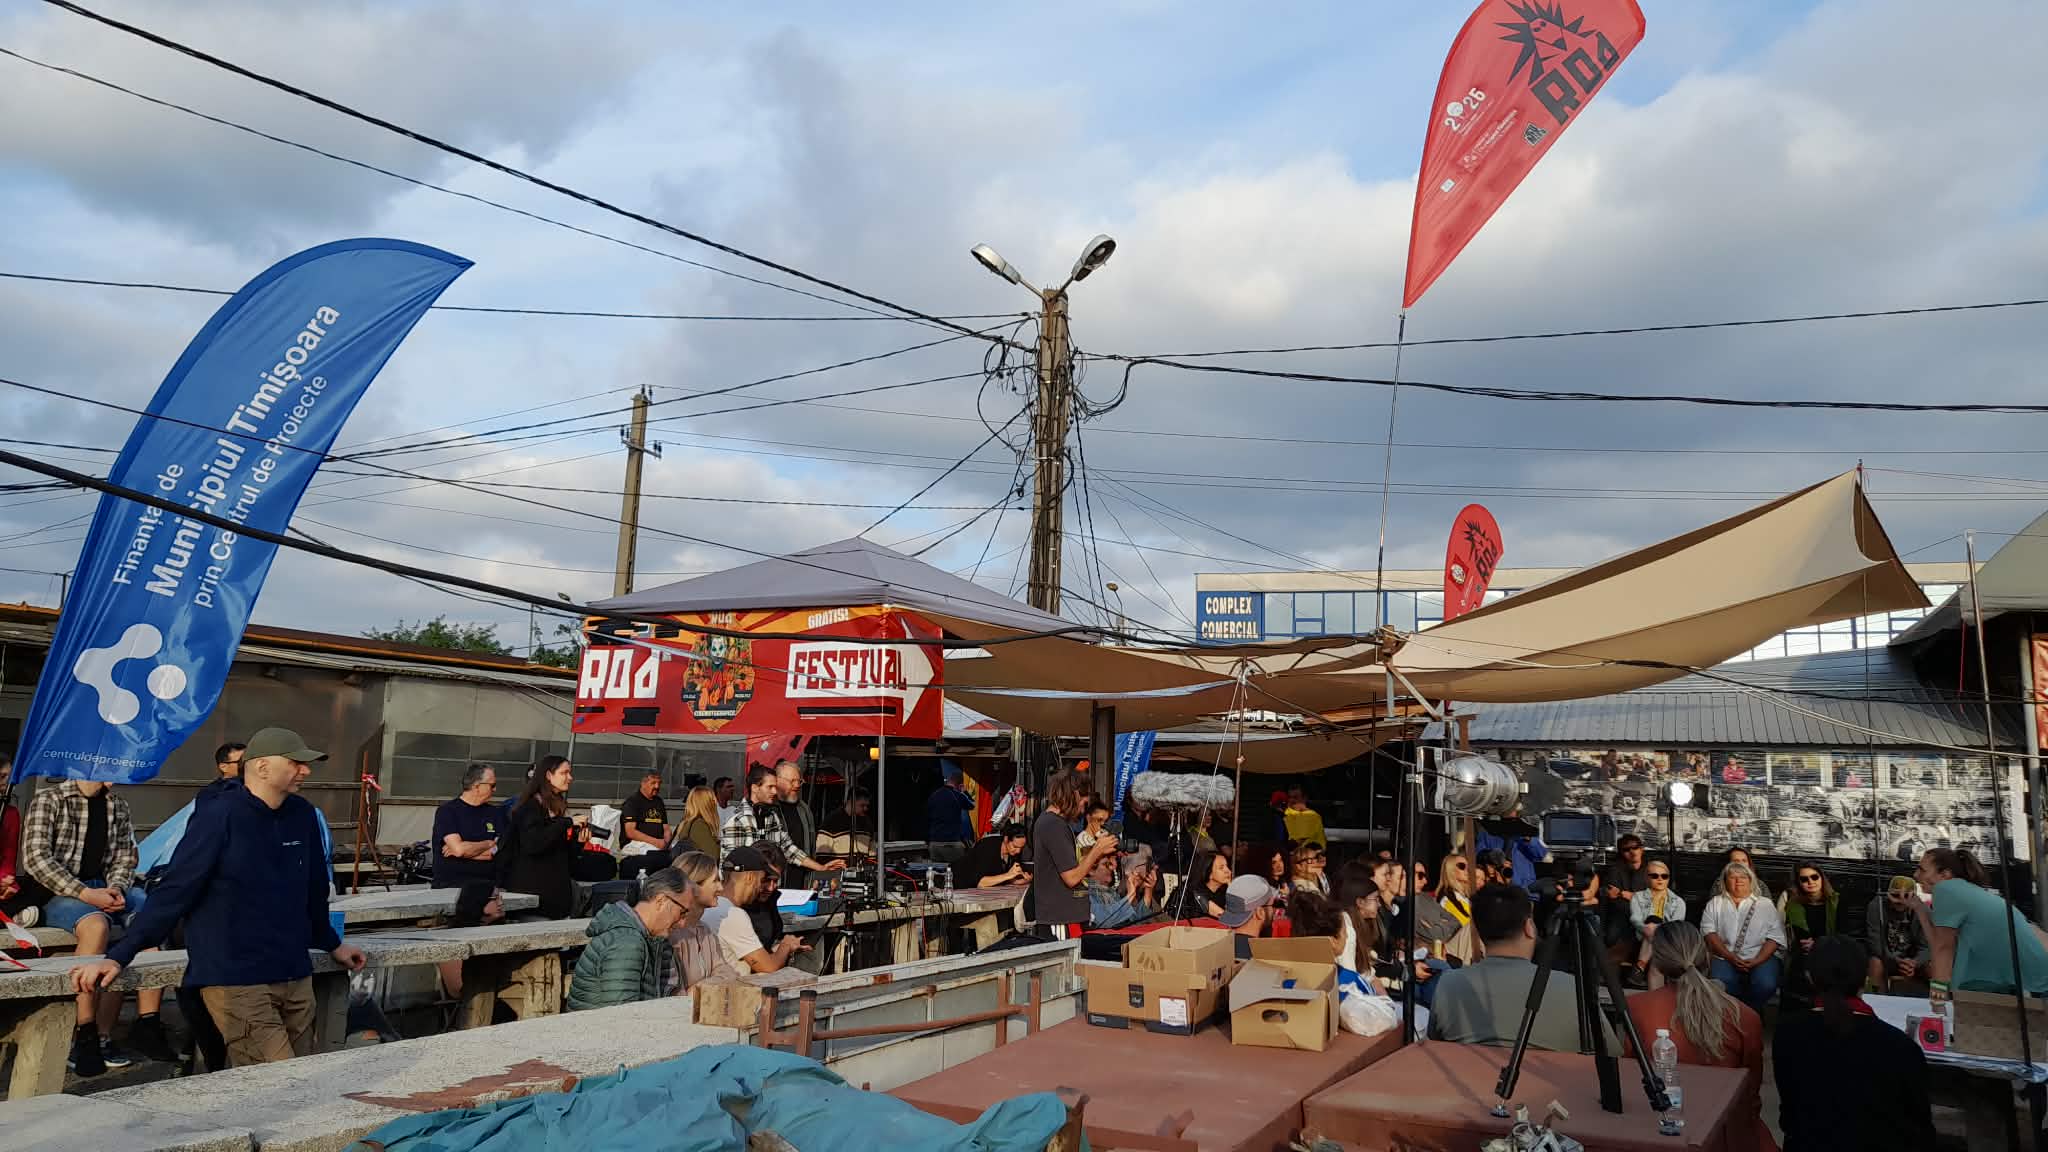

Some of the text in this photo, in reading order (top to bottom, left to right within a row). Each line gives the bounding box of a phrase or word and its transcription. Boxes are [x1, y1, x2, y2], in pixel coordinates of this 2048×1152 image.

[225, 306, 340, 434] Timișoara
[194, 376, 328, 608] prin Cetrul de Proiecte
[112, 463, 184, 585] Finanța de
[807, 608, 849, 629] GRATIS!
[1205, 596, 1252, 615] COMPLEX
[1201, 621, 1259, 639] COMERCIAL
[793, 648, 908, 691] FESTIVAL
